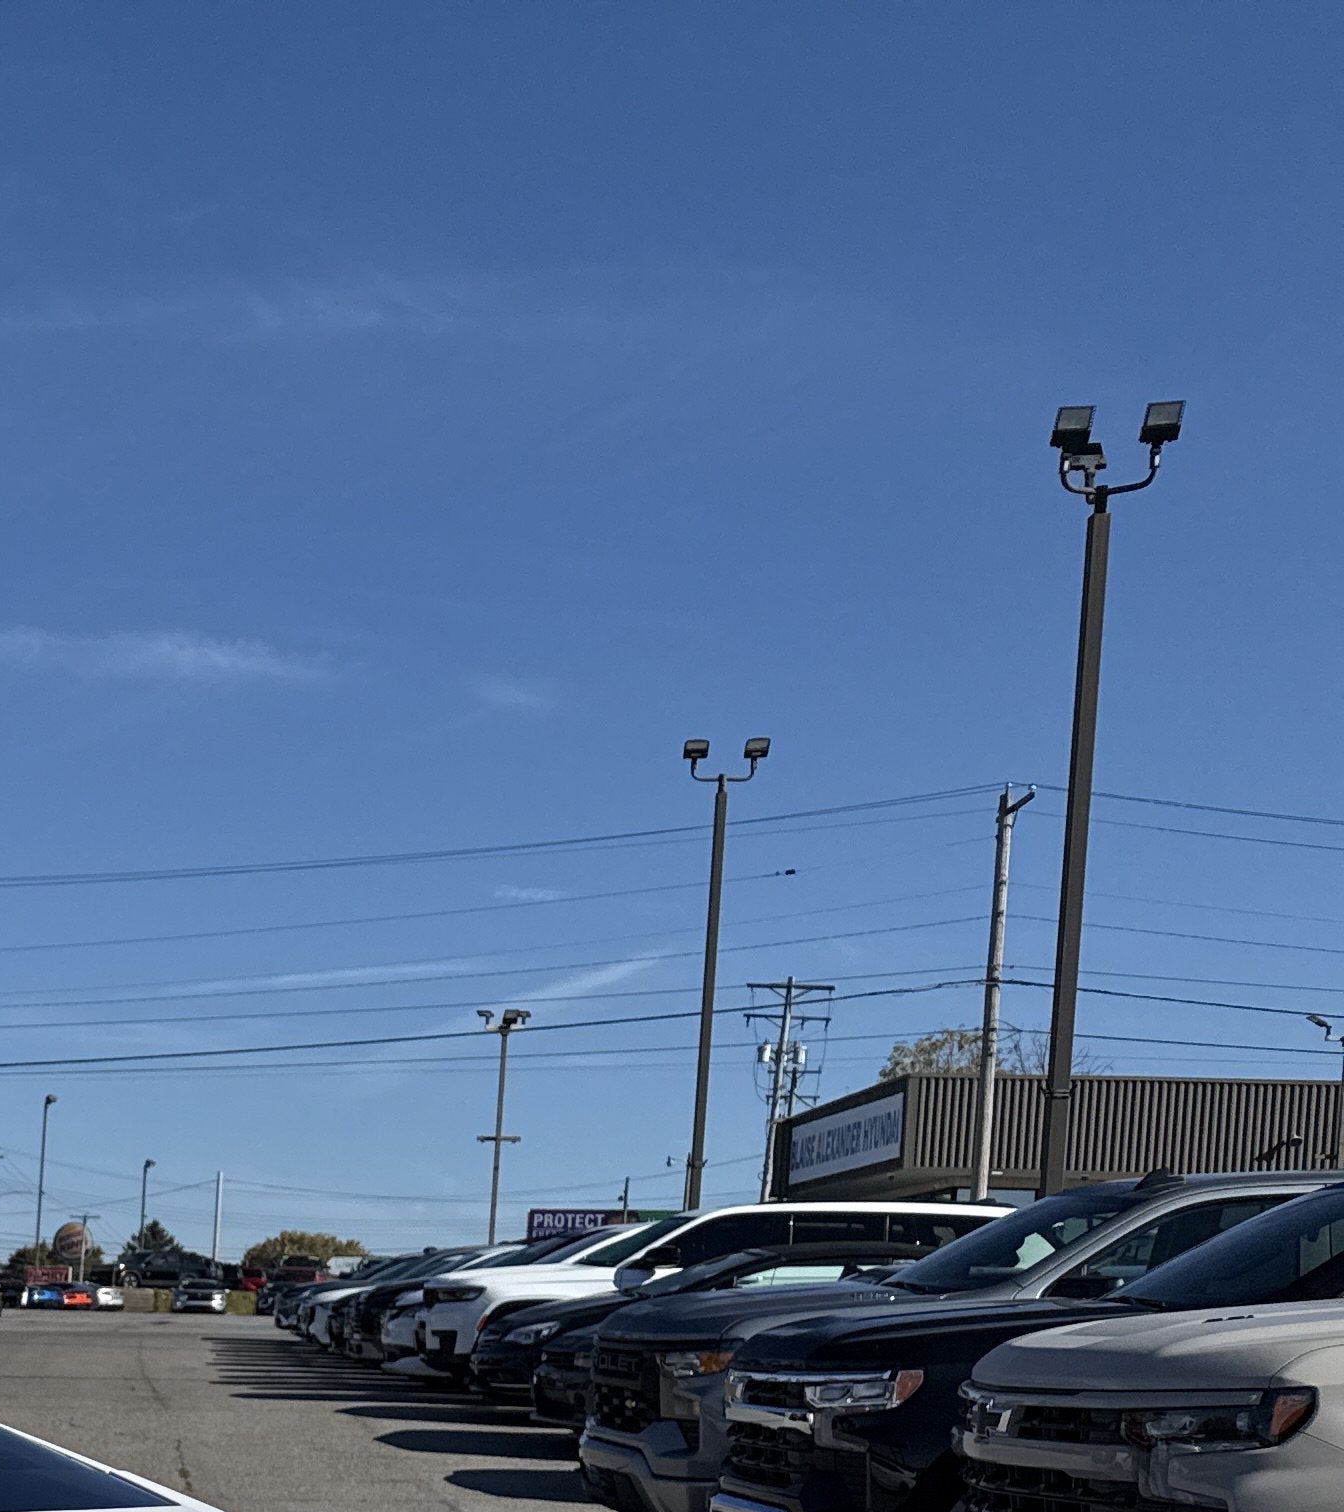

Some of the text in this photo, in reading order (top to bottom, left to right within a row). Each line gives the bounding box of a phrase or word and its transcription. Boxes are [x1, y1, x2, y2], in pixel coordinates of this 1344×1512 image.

[816, 1120, 862, 1165] ALEXANDER
[862, 1107, 901, 1153] HYUNDAI
[532, 1213, 606, 1228] PROTECT
